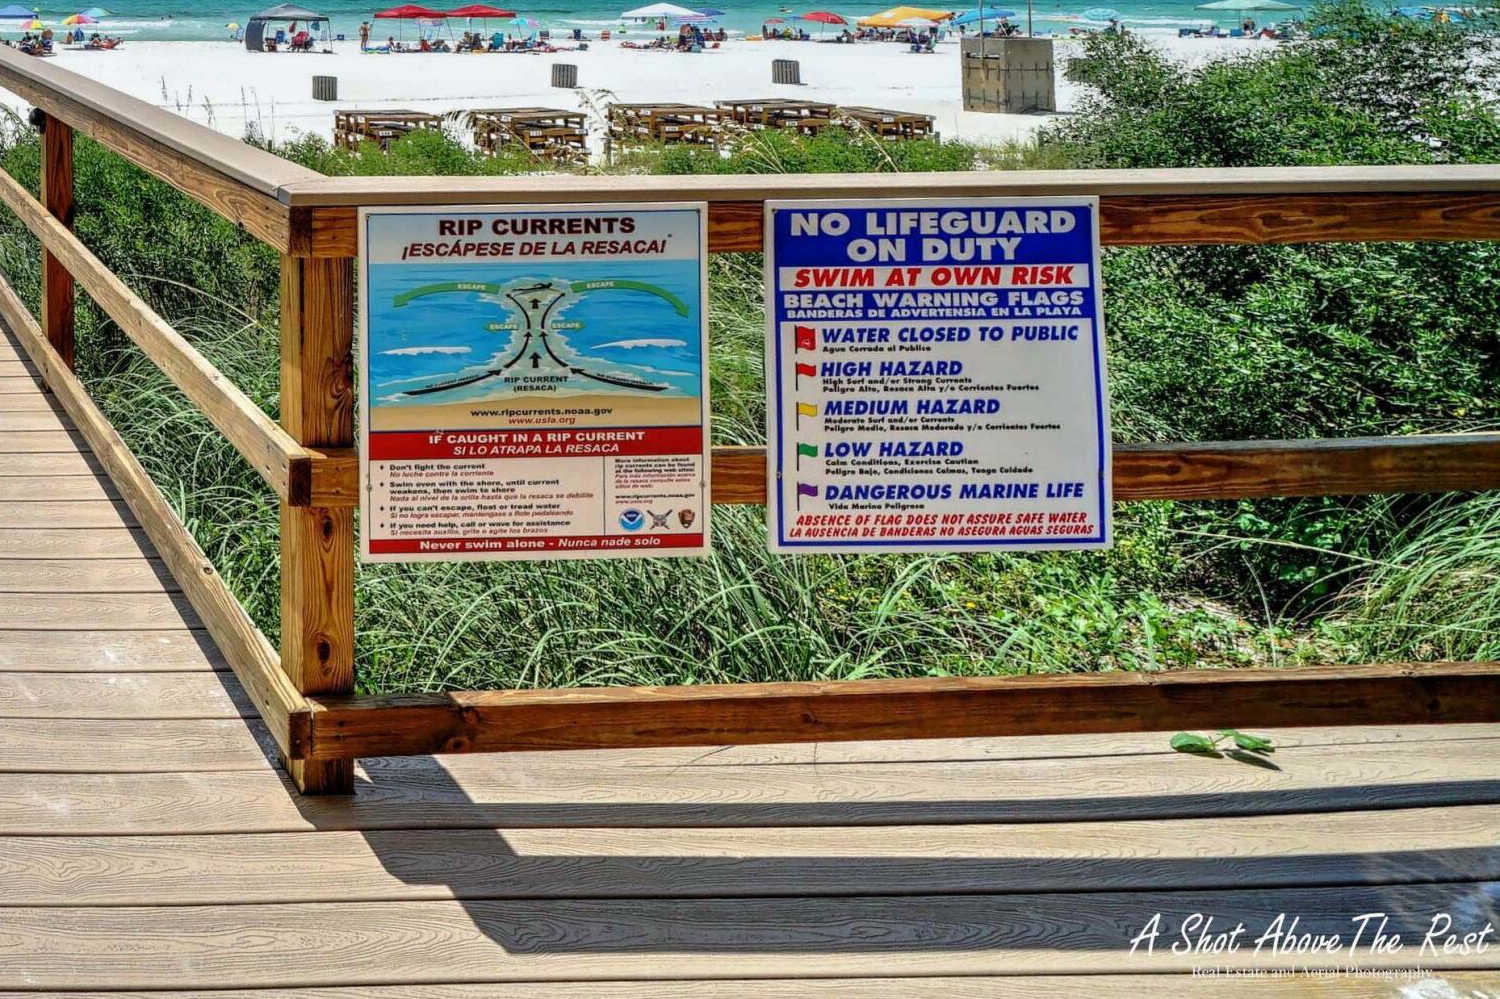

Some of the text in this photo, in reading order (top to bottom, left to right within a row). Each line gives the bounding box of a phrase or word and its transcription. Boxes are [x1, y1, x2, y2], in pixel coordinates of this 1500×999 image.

[439, 216, 635, 235] RIP CURRENTS
[790, 210, 1075, 236] NO LIFEGUARD
[401, 239, 666, 260] ¡ESCÁPESE DE LA RESACA!
[846, 236, 1021, 262] ON DUTY
[794, 265, 1073, 287] SWIM AT OWN RISK
[783, 290, 1083, 308] BEACH WARNING FLAGS
[787, 306, 1081, 318] BANDERAS DE ADVERTENSIA EN LA PLAYA
[822, 325, 1078, 343] WATER CLOSED TO PUBLIC
[822, 345, 845, 354] Agua
[820, 360, 962, 376] HIGH HAZARD
[822, 378, 843, 386] High
[902, 377, 932, 386] Strong
[470, 408, 613, 416] www.ripcurrents.noaa.gov
[824, 398, 1000, 415] MEDIUM HAZARD
[508, 416, 576, 425] www.usla.org
[429, 431, 644, 444] IF CAUGHT IN A RIP CURRENT
[453, 443, 619, 455] SI LO ATRAPA LA RESACA
[824, 441, 963, 457] LOW HAZARD
[850, 458, 901, 466] Conditions,
[824, 482, 1084, 500] DANGEROUS MARINE LIFE
[796, 512, 1087, 526] ABSENCE OF FLAG DOES NOT ASSURE SAFE WATER
[789, 524, 1093, 537] LA AUSENCIA DE BANDERAS NO ASEGURA AGUAS SEGURAS
[419, 540, 461, 549] Never
[465, 539, 502, 548] swim
[506, 539, 545, 548] alone
[558, 538, 597, 547] Nunca
[600, 536, 631, 546] nade
[634, 536, 660, 545] solo
